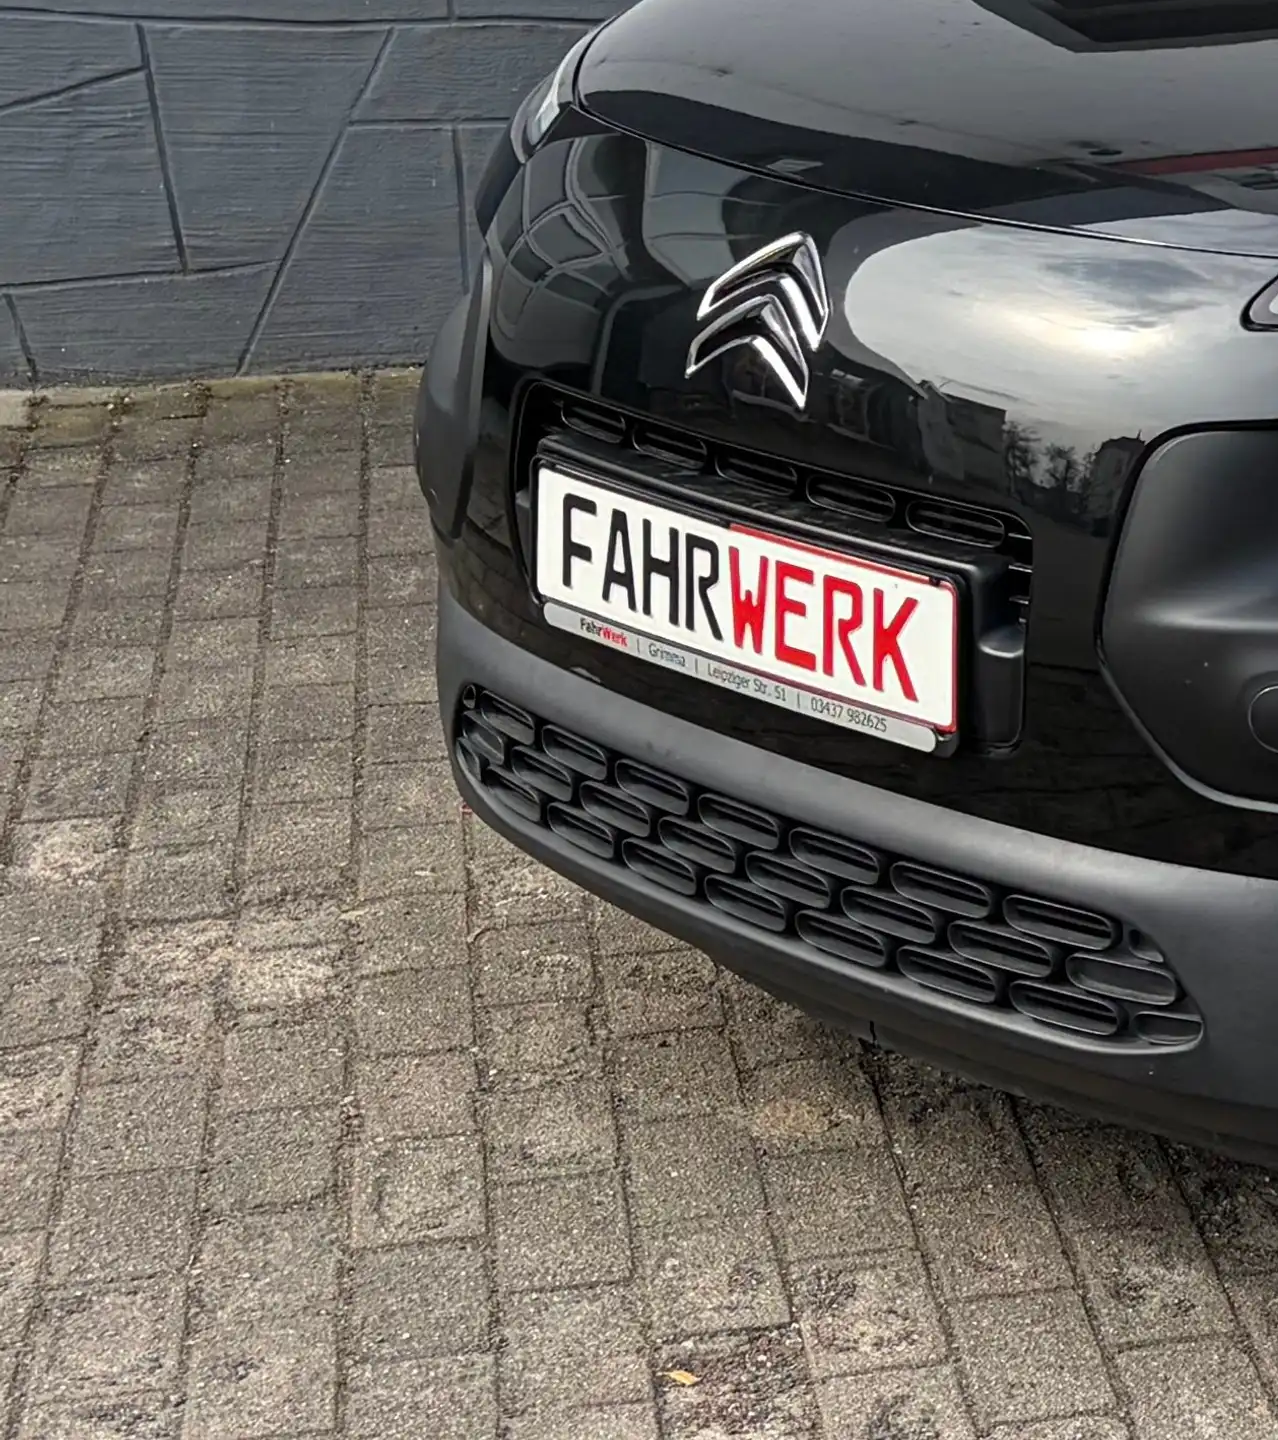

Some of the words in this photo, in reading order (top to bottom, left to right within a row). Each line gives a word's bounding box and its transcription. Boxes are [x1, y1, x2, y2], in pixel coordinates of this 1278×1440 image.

[561, 492, 920, 704] FAHRWERK
[580, 617, 628, 648] FahrWerk
[707, 662, 750, 690] Leipziger
[753, 679, 772, 697] Str.
[774, 685, 787, 702] 51
[810, 696, 844, 719] 03437
[846, 707, 887, 733] 982625
